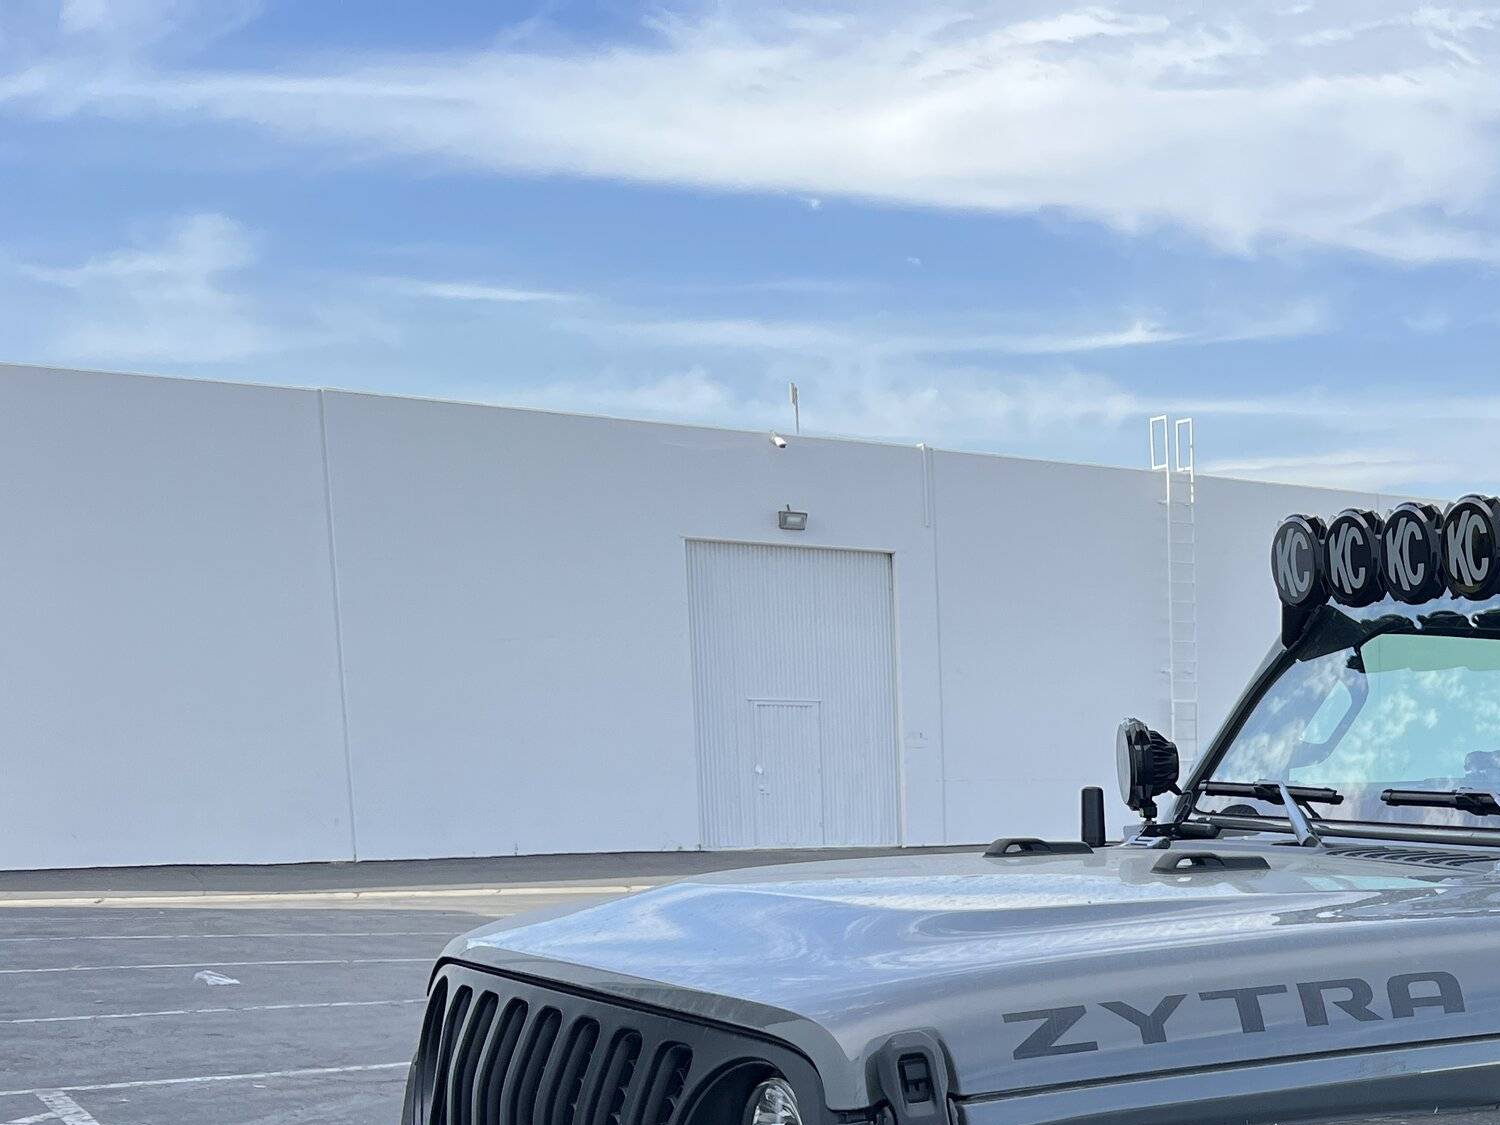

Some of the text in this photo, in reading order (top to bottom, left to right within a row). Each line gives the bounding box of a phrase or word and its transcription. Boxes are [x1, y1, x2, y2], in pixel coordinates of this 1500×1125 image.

[1276, 528, 1309, 597] KC
[1329, 523, 1365, 594] KC
[1386, 517, 1424, 591] KC
[1447, 510, 1489, 587] KC
[1002, 971, 1466, 1060] ZYTRA
